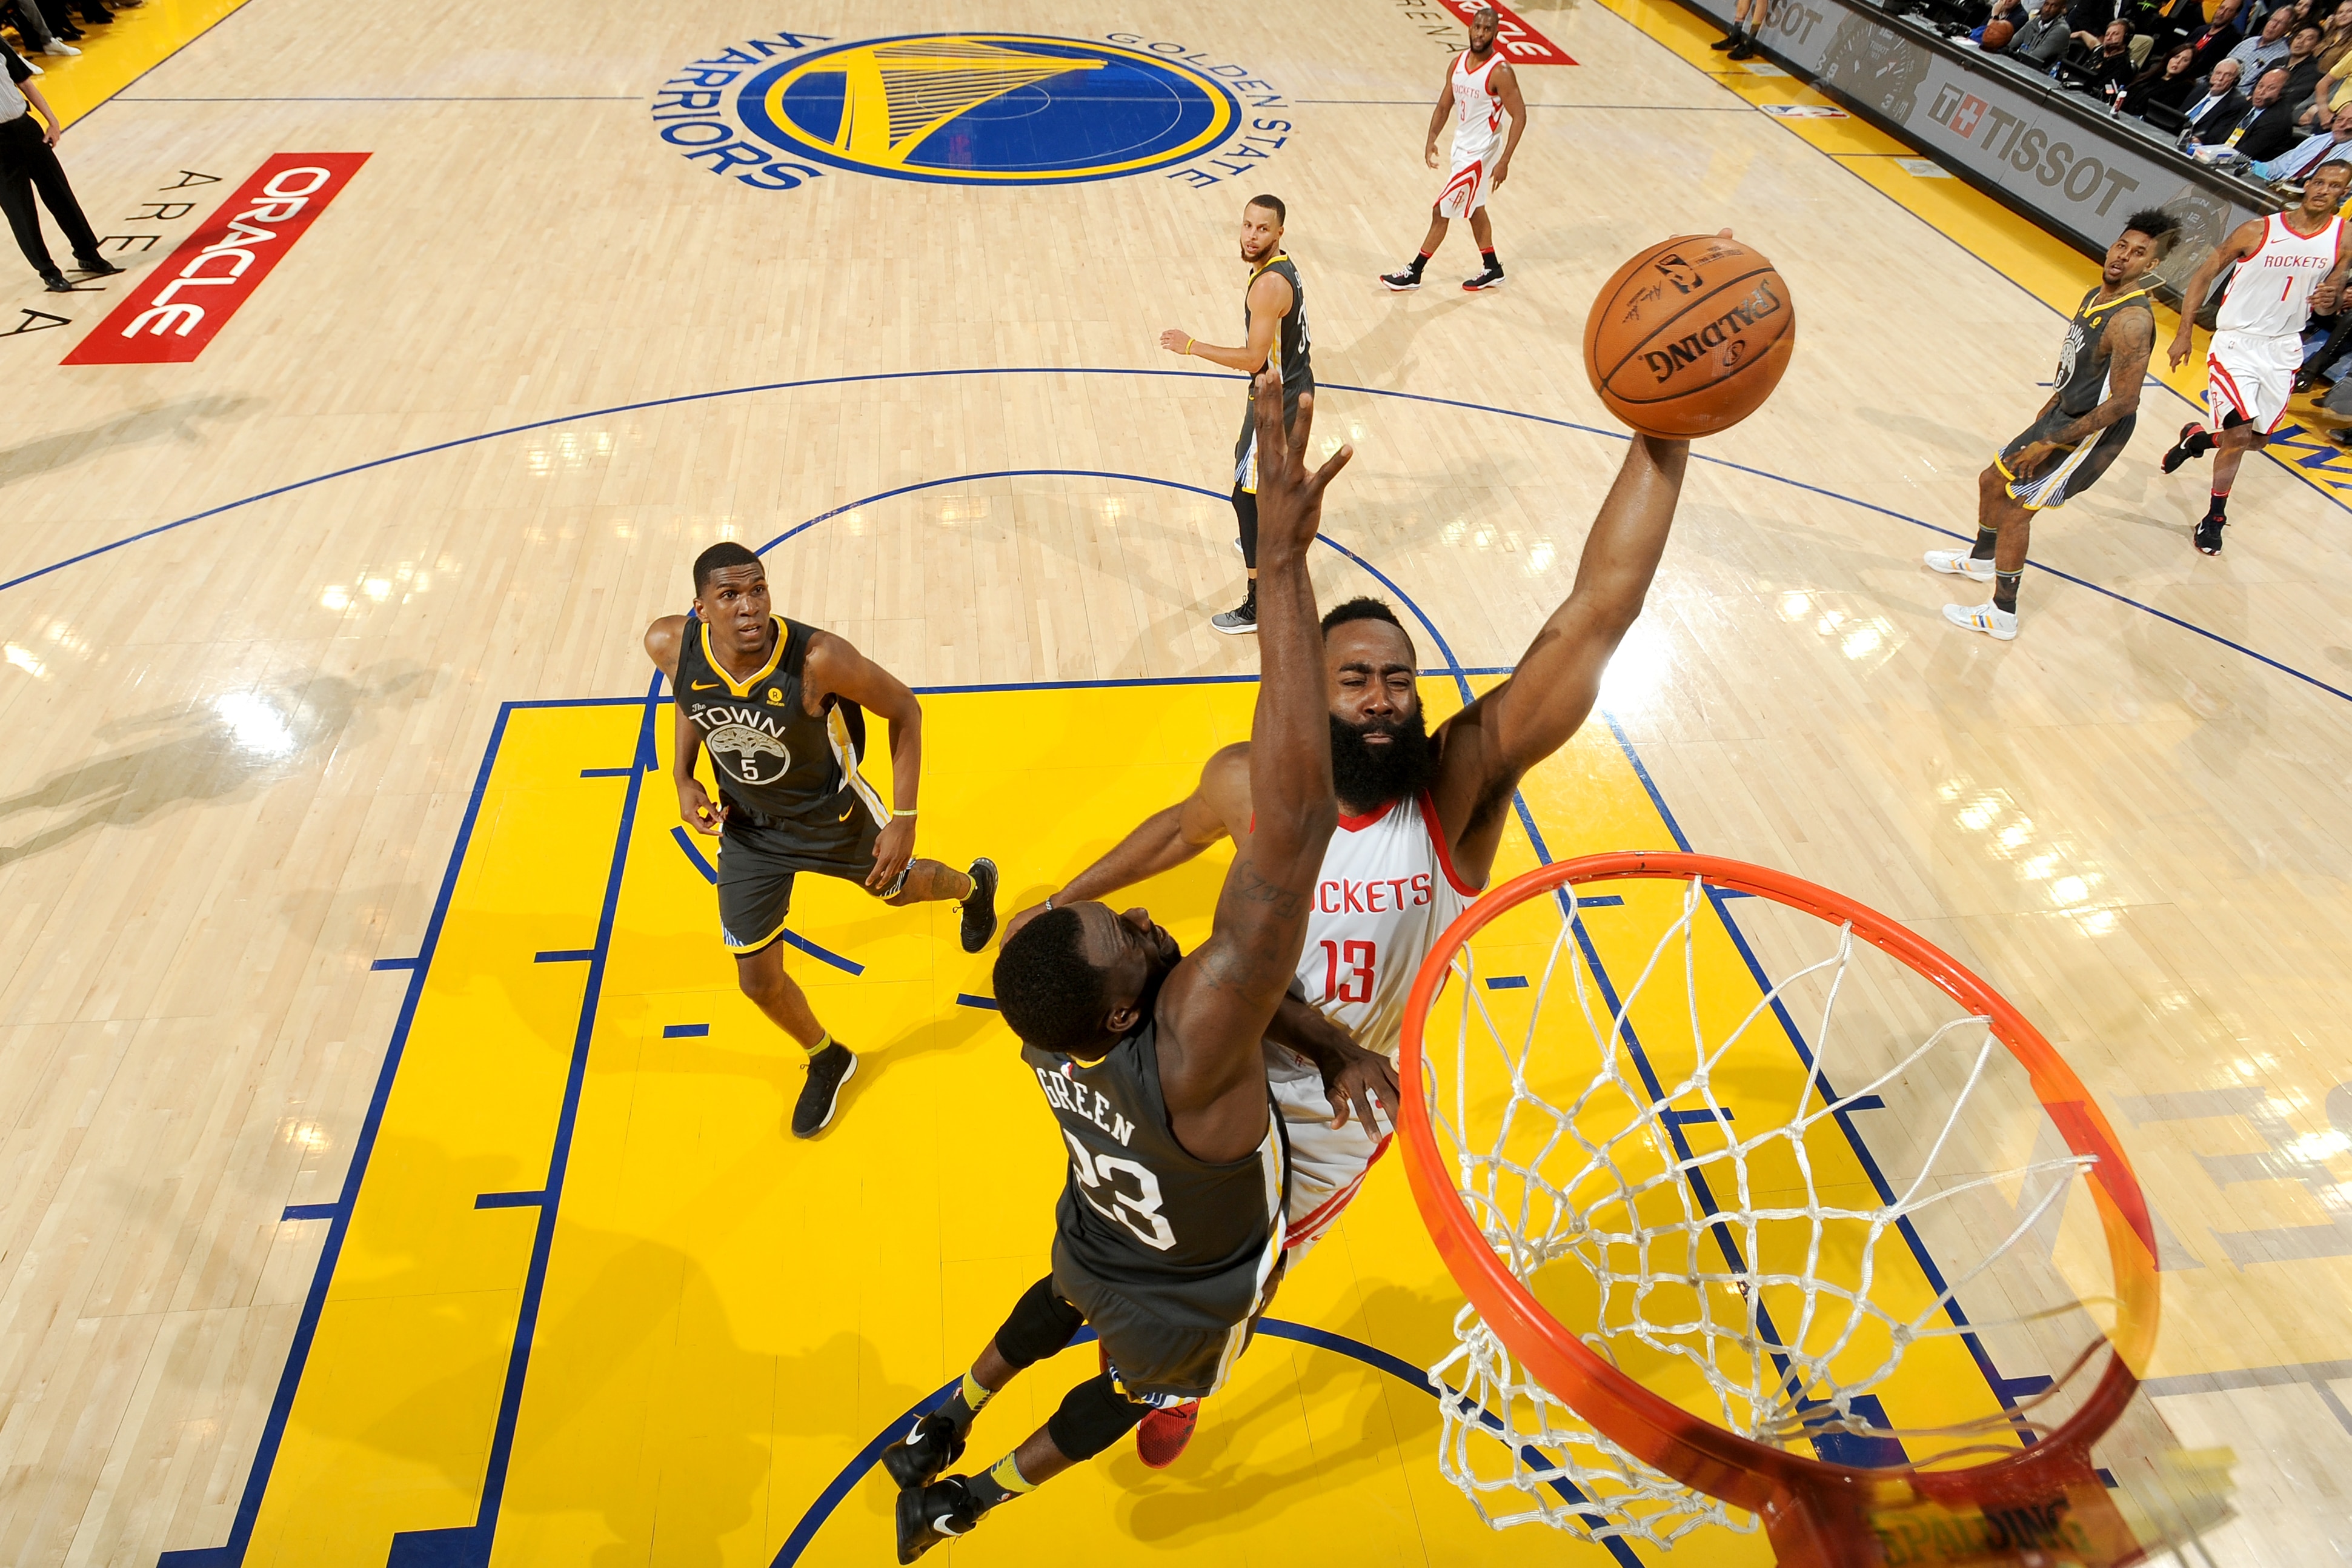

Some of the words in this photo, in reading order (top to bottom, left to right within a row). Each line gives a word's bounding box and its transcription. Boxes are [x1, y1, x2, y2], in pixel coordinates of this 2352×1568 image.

[1106, 33, 1288, 107] GOLDEN
[651, 31, 834, 190] WARRIORS
[1460, 99, 1466, 121] 3
[1166, 118, 1292, 188] STATE
[1980, 106, 2140, 218] TISSOT
[0, 170, 222, 337] ARENA
[121, 166, 331, 339] ORACLE
[2264, 255, 2328, 269] ROCKETS
[2281, 276, 2294, 302] 1
[1642, 278, 1781, 384] SPALDING
[2065, 324, 2086, 353] OWN
[2055, 369, 2064, 388] 6
[688, 706, 786, 739] TOWN
[691, 703, 707, 713] The
[741, 759, 760, 781] 5
[1309, 873, 1432, 914] CKETS
[1320, 939, 1377, 1003] 13
[1036, 1067, 1135, 1148] GREEN
[1063, 1128, 1177, 1251] 23
